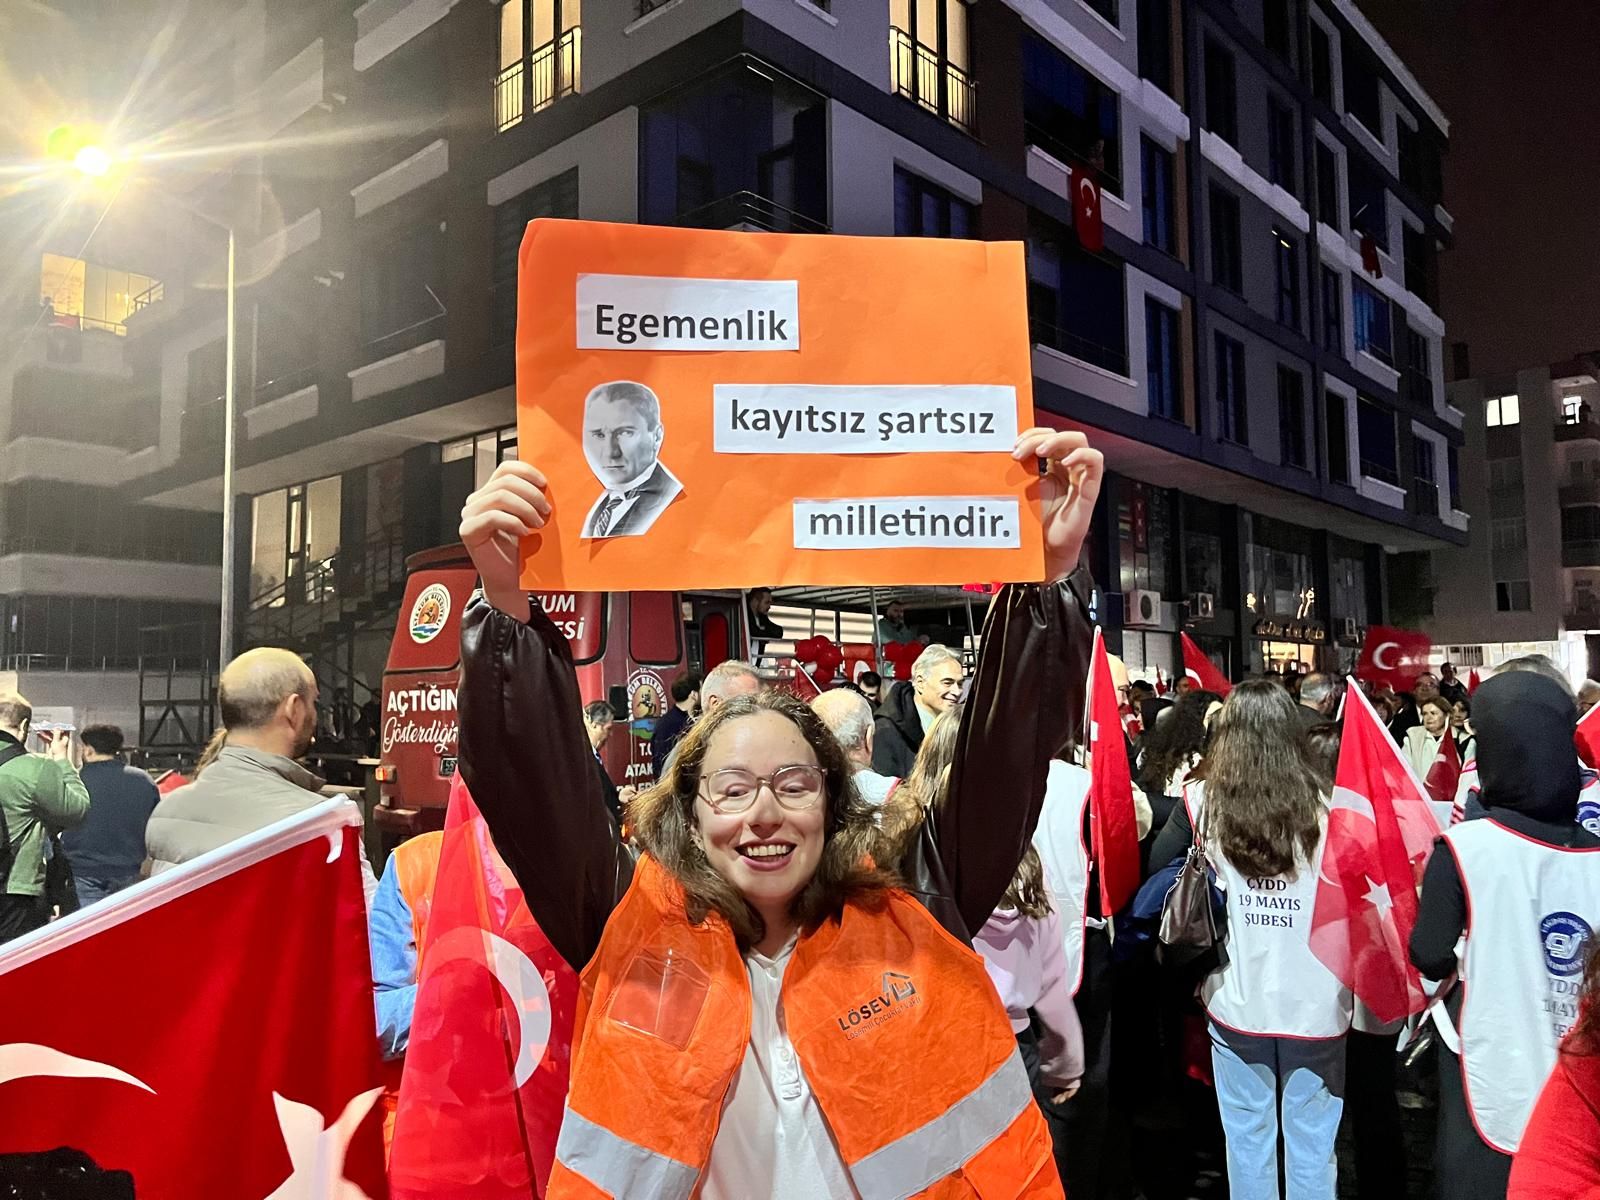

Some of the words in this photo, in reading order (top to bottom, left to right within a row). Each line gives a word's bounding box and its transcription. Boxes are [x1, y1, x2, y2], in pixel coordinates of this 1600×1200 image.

[595, 303, 788, 344] Egemenlik
[731, 399, 866, 439] kayıtsız
[877, 406, 995, 441] şartsız
[809, 504, 1011, 538] milletindir.
[1246, 877, 1287, 891] ÇYDD
[1239, 893, 1252, 907] 19
[1255, 895, 1301, 911] MAYIS
[1244, 912, 1293, 928] ŞUBESİ
[838, 991, 892, 1031] LÖSEV
